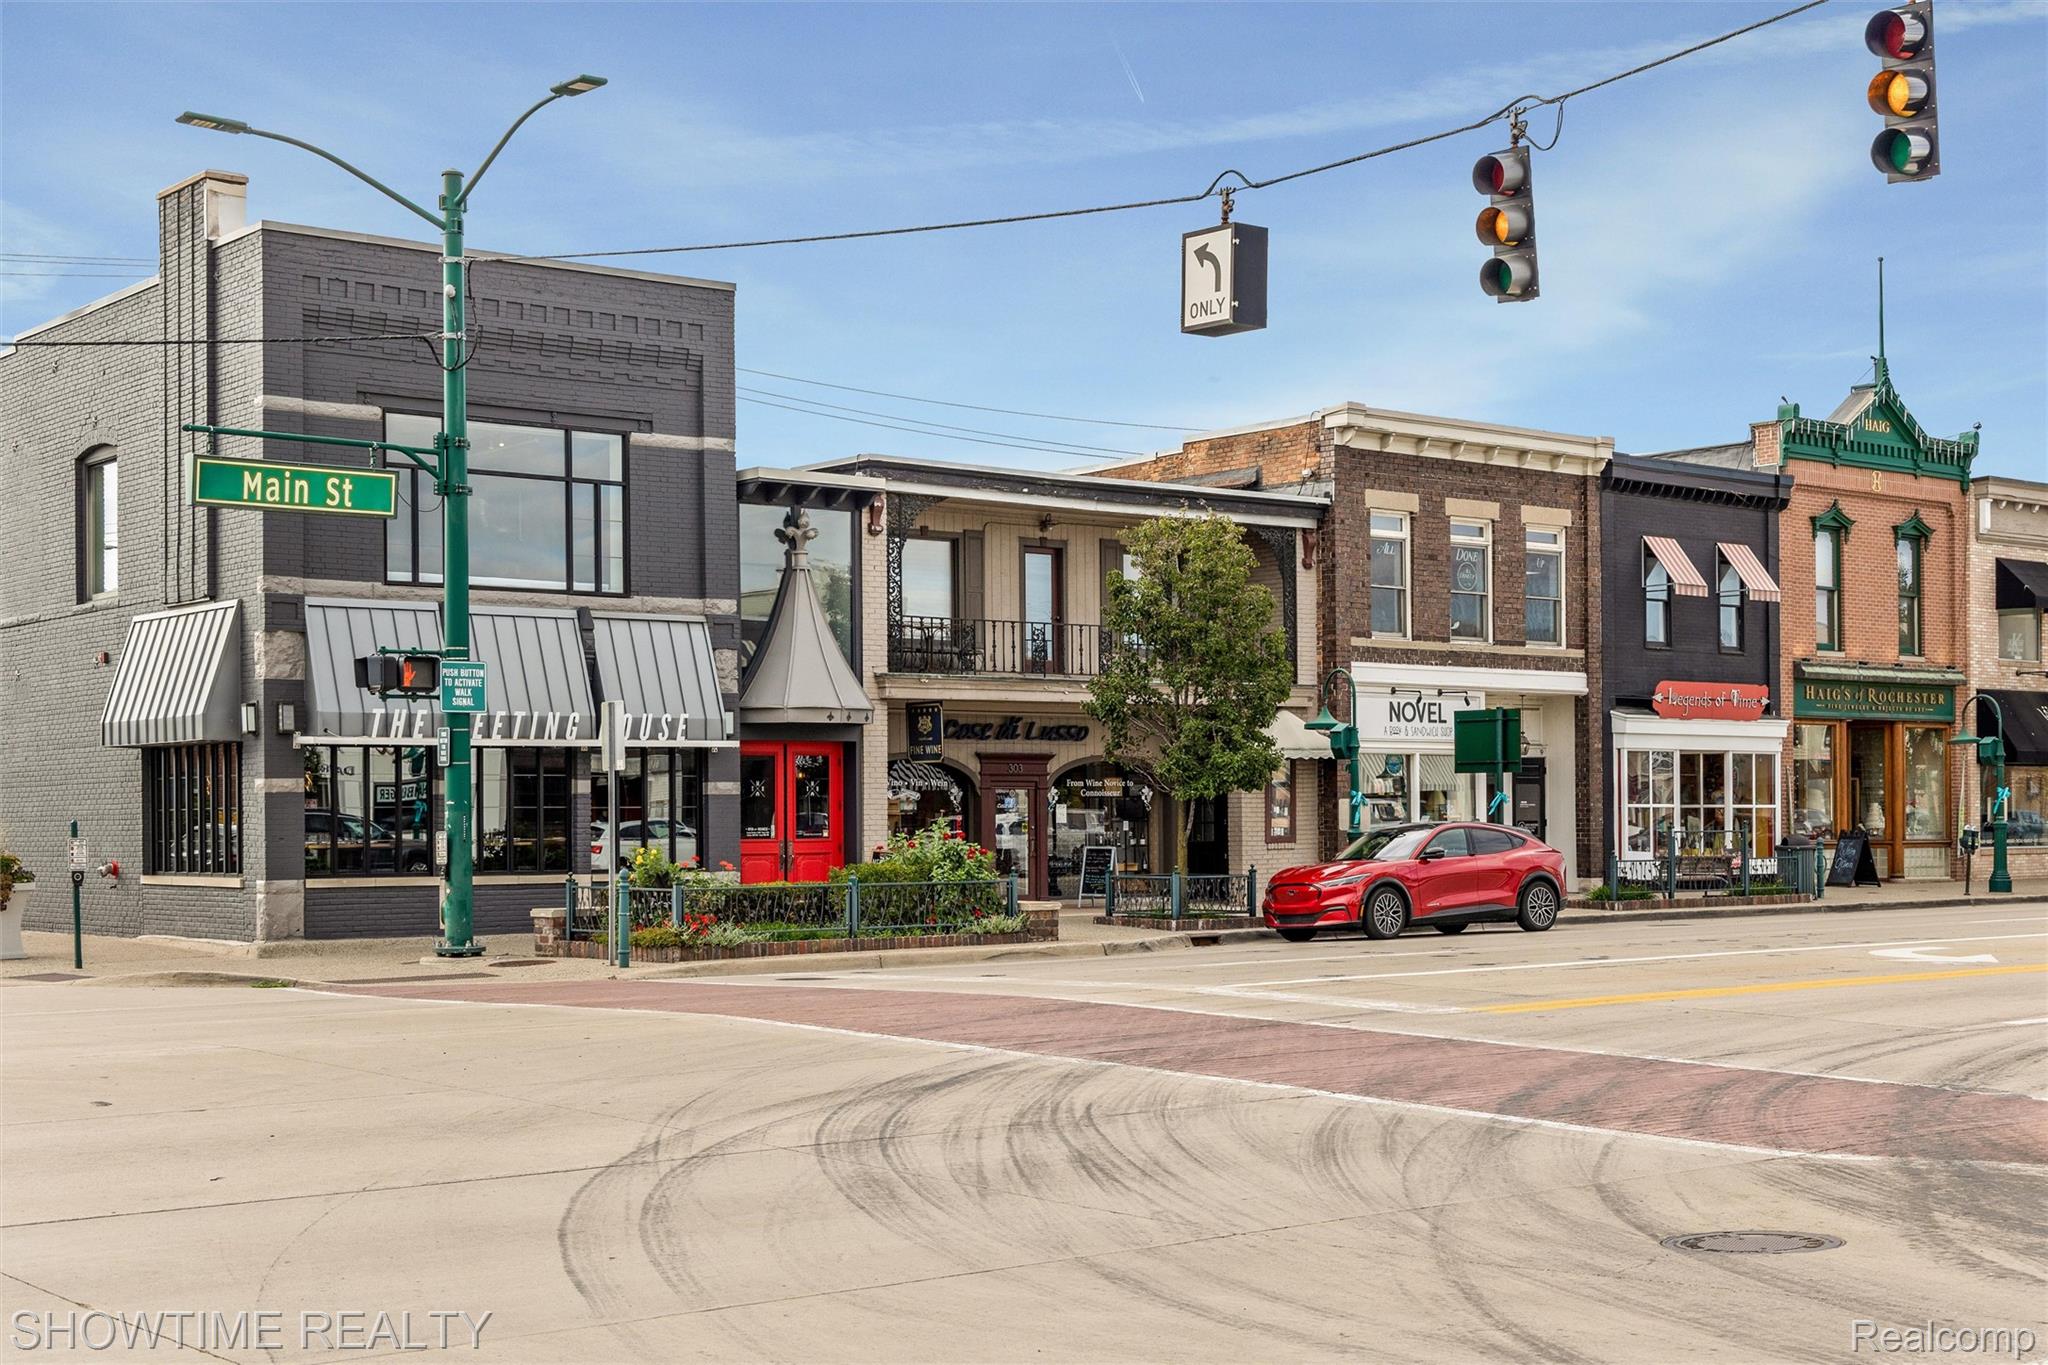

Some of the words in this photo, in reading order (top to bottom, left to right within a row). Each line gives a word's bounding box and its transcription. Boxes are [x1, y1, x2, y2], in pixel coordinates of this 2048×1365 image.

[1190, 297, 1226, 319] ONLY
[1865, 418, 1890, 434] HAIG
[242, 471, 309, 504] Main
[326, 477, 353, 507] St
[1456, 548, 1479, 561] DONE
[442, 668, 459, 677] PUSH
[460, 668, 484, 678] BUTTON
[444, 678, 453, 687] TO
[454, 678, 483, 687] ACTIVATE
[454, 688, 472, 697] WALK
[1805, 685, 1851, 701] HAIG'S
[1868, 687, 1945, 705] ROCHESTER
[452, 697, 475, 706] SIGNAL
[1667, 687, 1712, 716] Legends
[1715, 692, 1726, 707] of
[1731, 689, 1758, 708] Time
[1389, 701, 1448, 724] NOVEL
[371, 708, 428, 739] THE
[472, 711, 580, 740] EETING
[622, 713, 689, 741] OUSE
[943, 719, 993, 740] Cose
[995, 715, 1023, 740] di
[1024, 721, 1089, 742] Lusso
[910, 745, 924, 755] FINE
[925, 744, 942, 754] WINE
[1008, 763, 1023, 774] 303
[930, 778, 948, 787] Wein
[1066, 779, 1084, 787] From
[1085, 779, 1102, 787] Wine
[1104, 778, 1124, 787] Novice
[1126, 779, 1134, 787] to
[1080, 788, 1122, 798] Connoisseur
